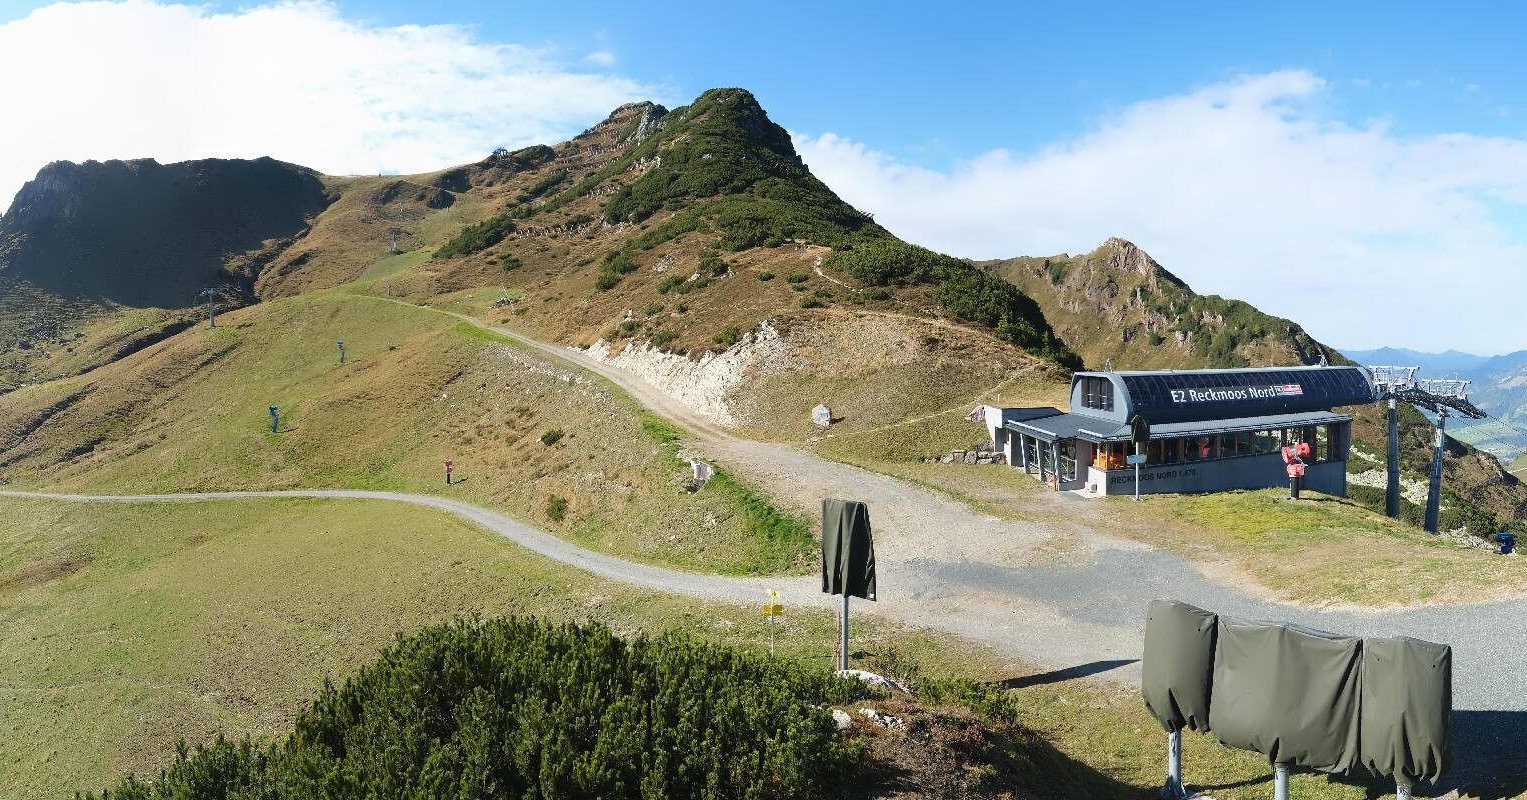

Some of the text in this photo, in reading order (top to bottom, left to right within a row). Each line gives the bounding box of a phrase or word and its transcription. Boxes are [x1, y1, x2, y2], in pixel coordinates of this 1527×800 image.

[1171, 390, 1186, 402] E2
[1189, 389, 1247, 402] Reckmoos
[1249, 386, 1275, 398] Nord
[1156, 470, 1177, 480] NORD
